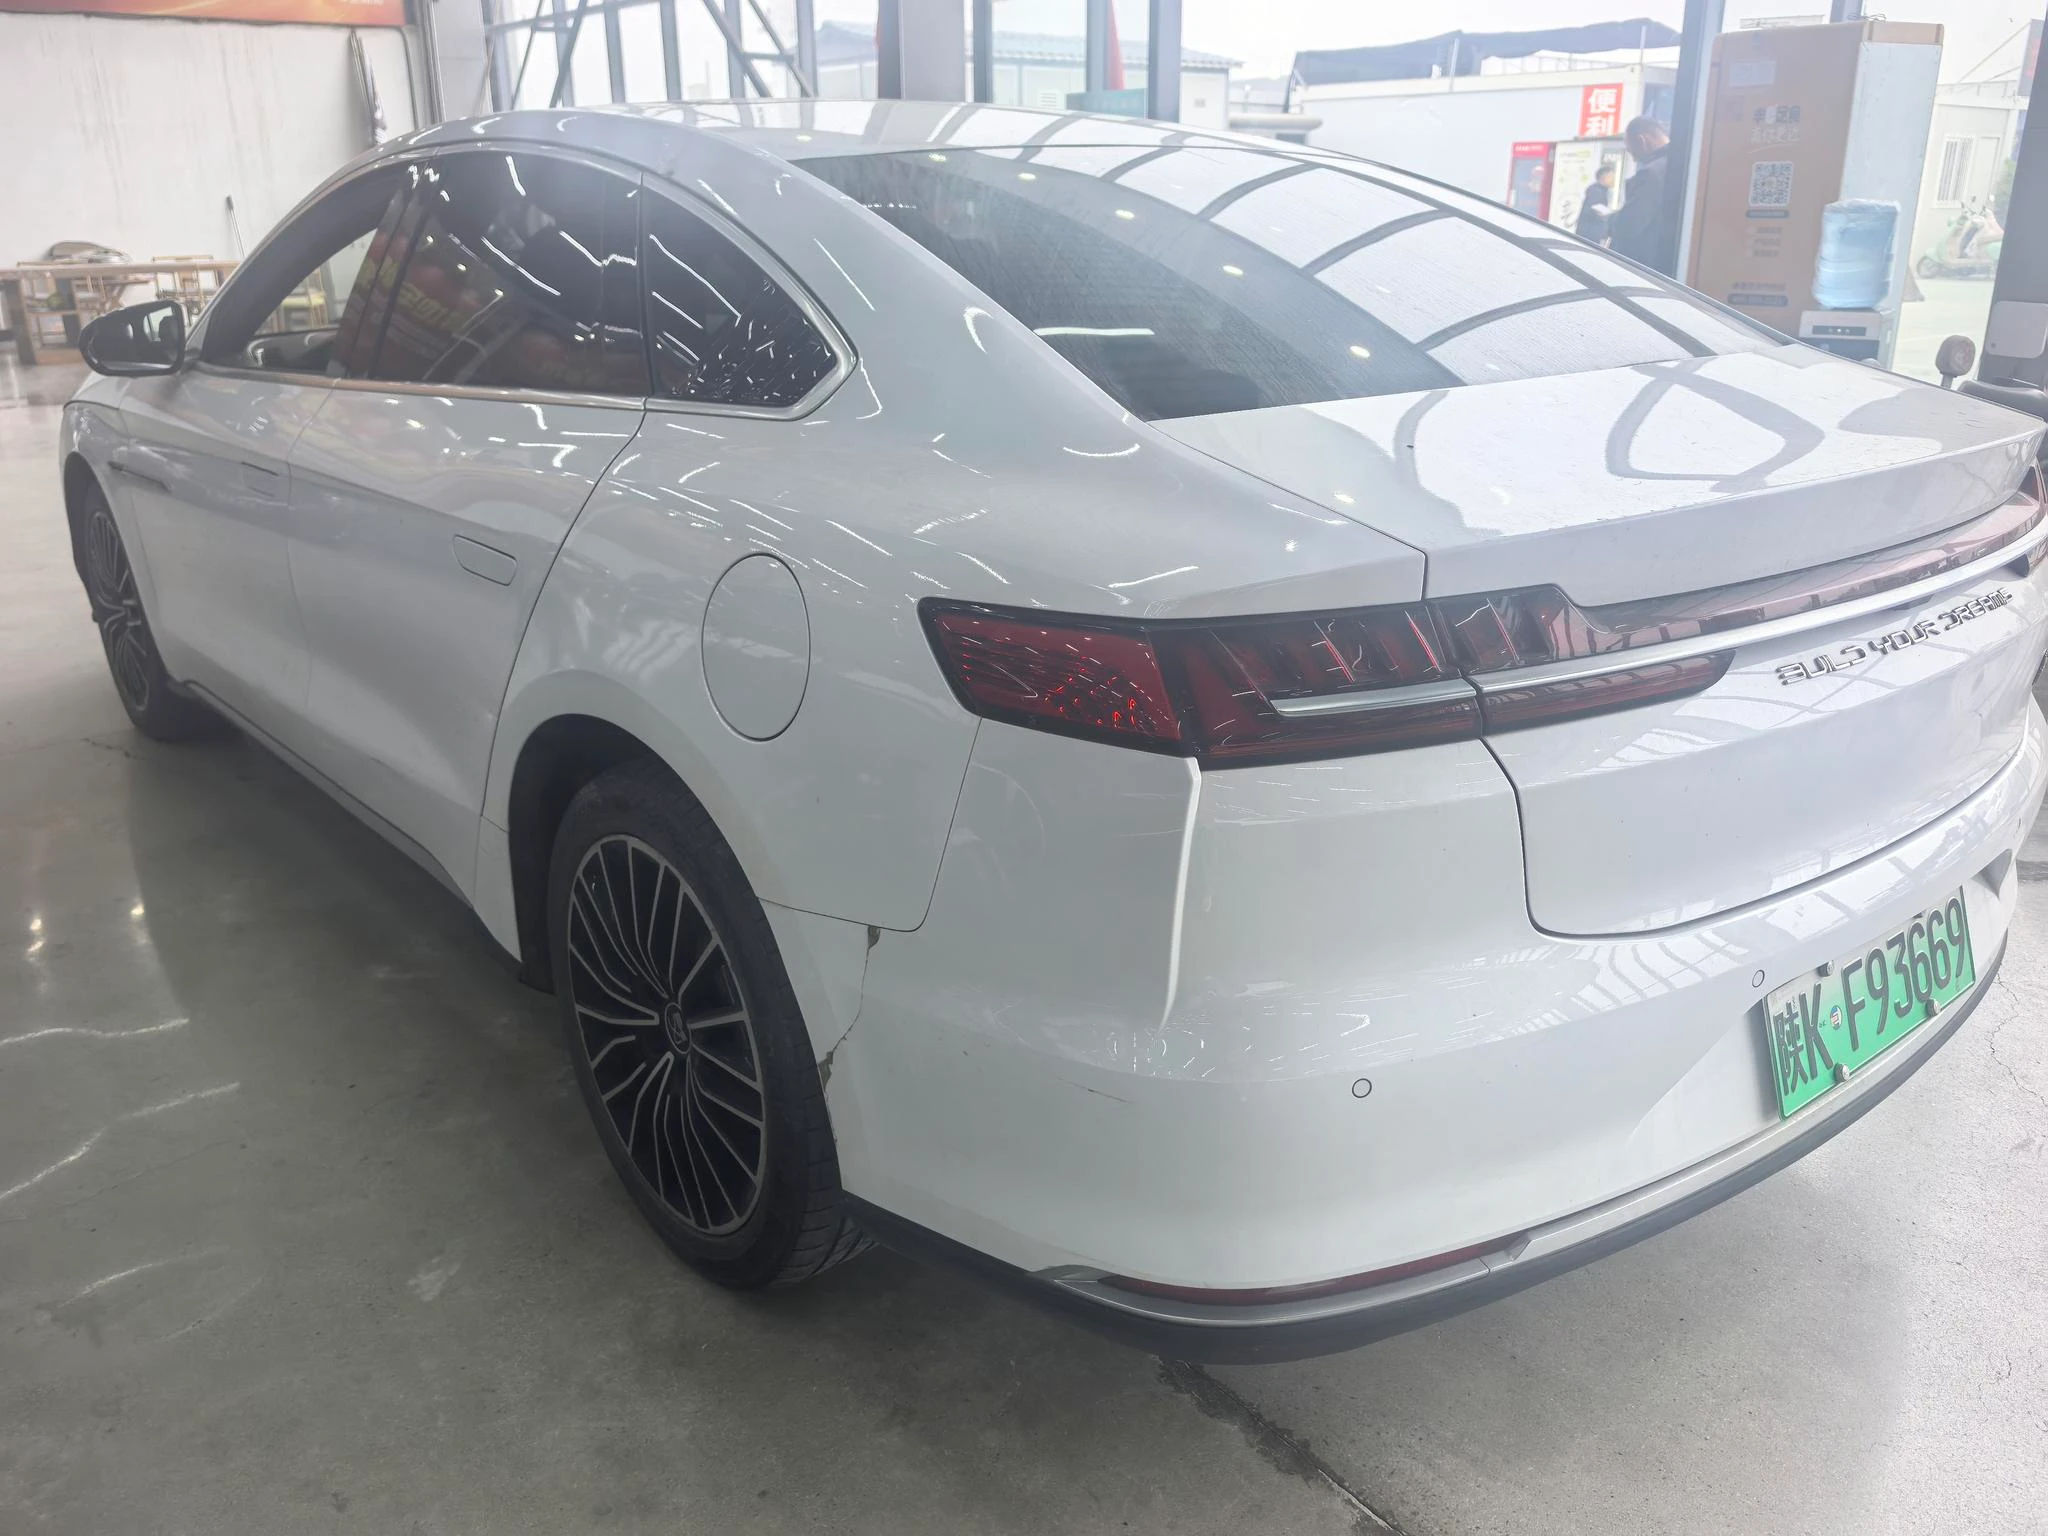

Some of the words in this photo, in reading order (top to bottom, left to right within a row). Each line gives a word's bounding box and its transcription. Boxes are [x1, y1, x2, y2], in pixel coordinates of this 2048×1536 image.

[1584, 88, 1617, 136] 便利
[1776, 645, 1866, 686] BUILD
[1868, 619, 1941, 655] YOUR
[1938, 587, 2013, 632] DREAMS
